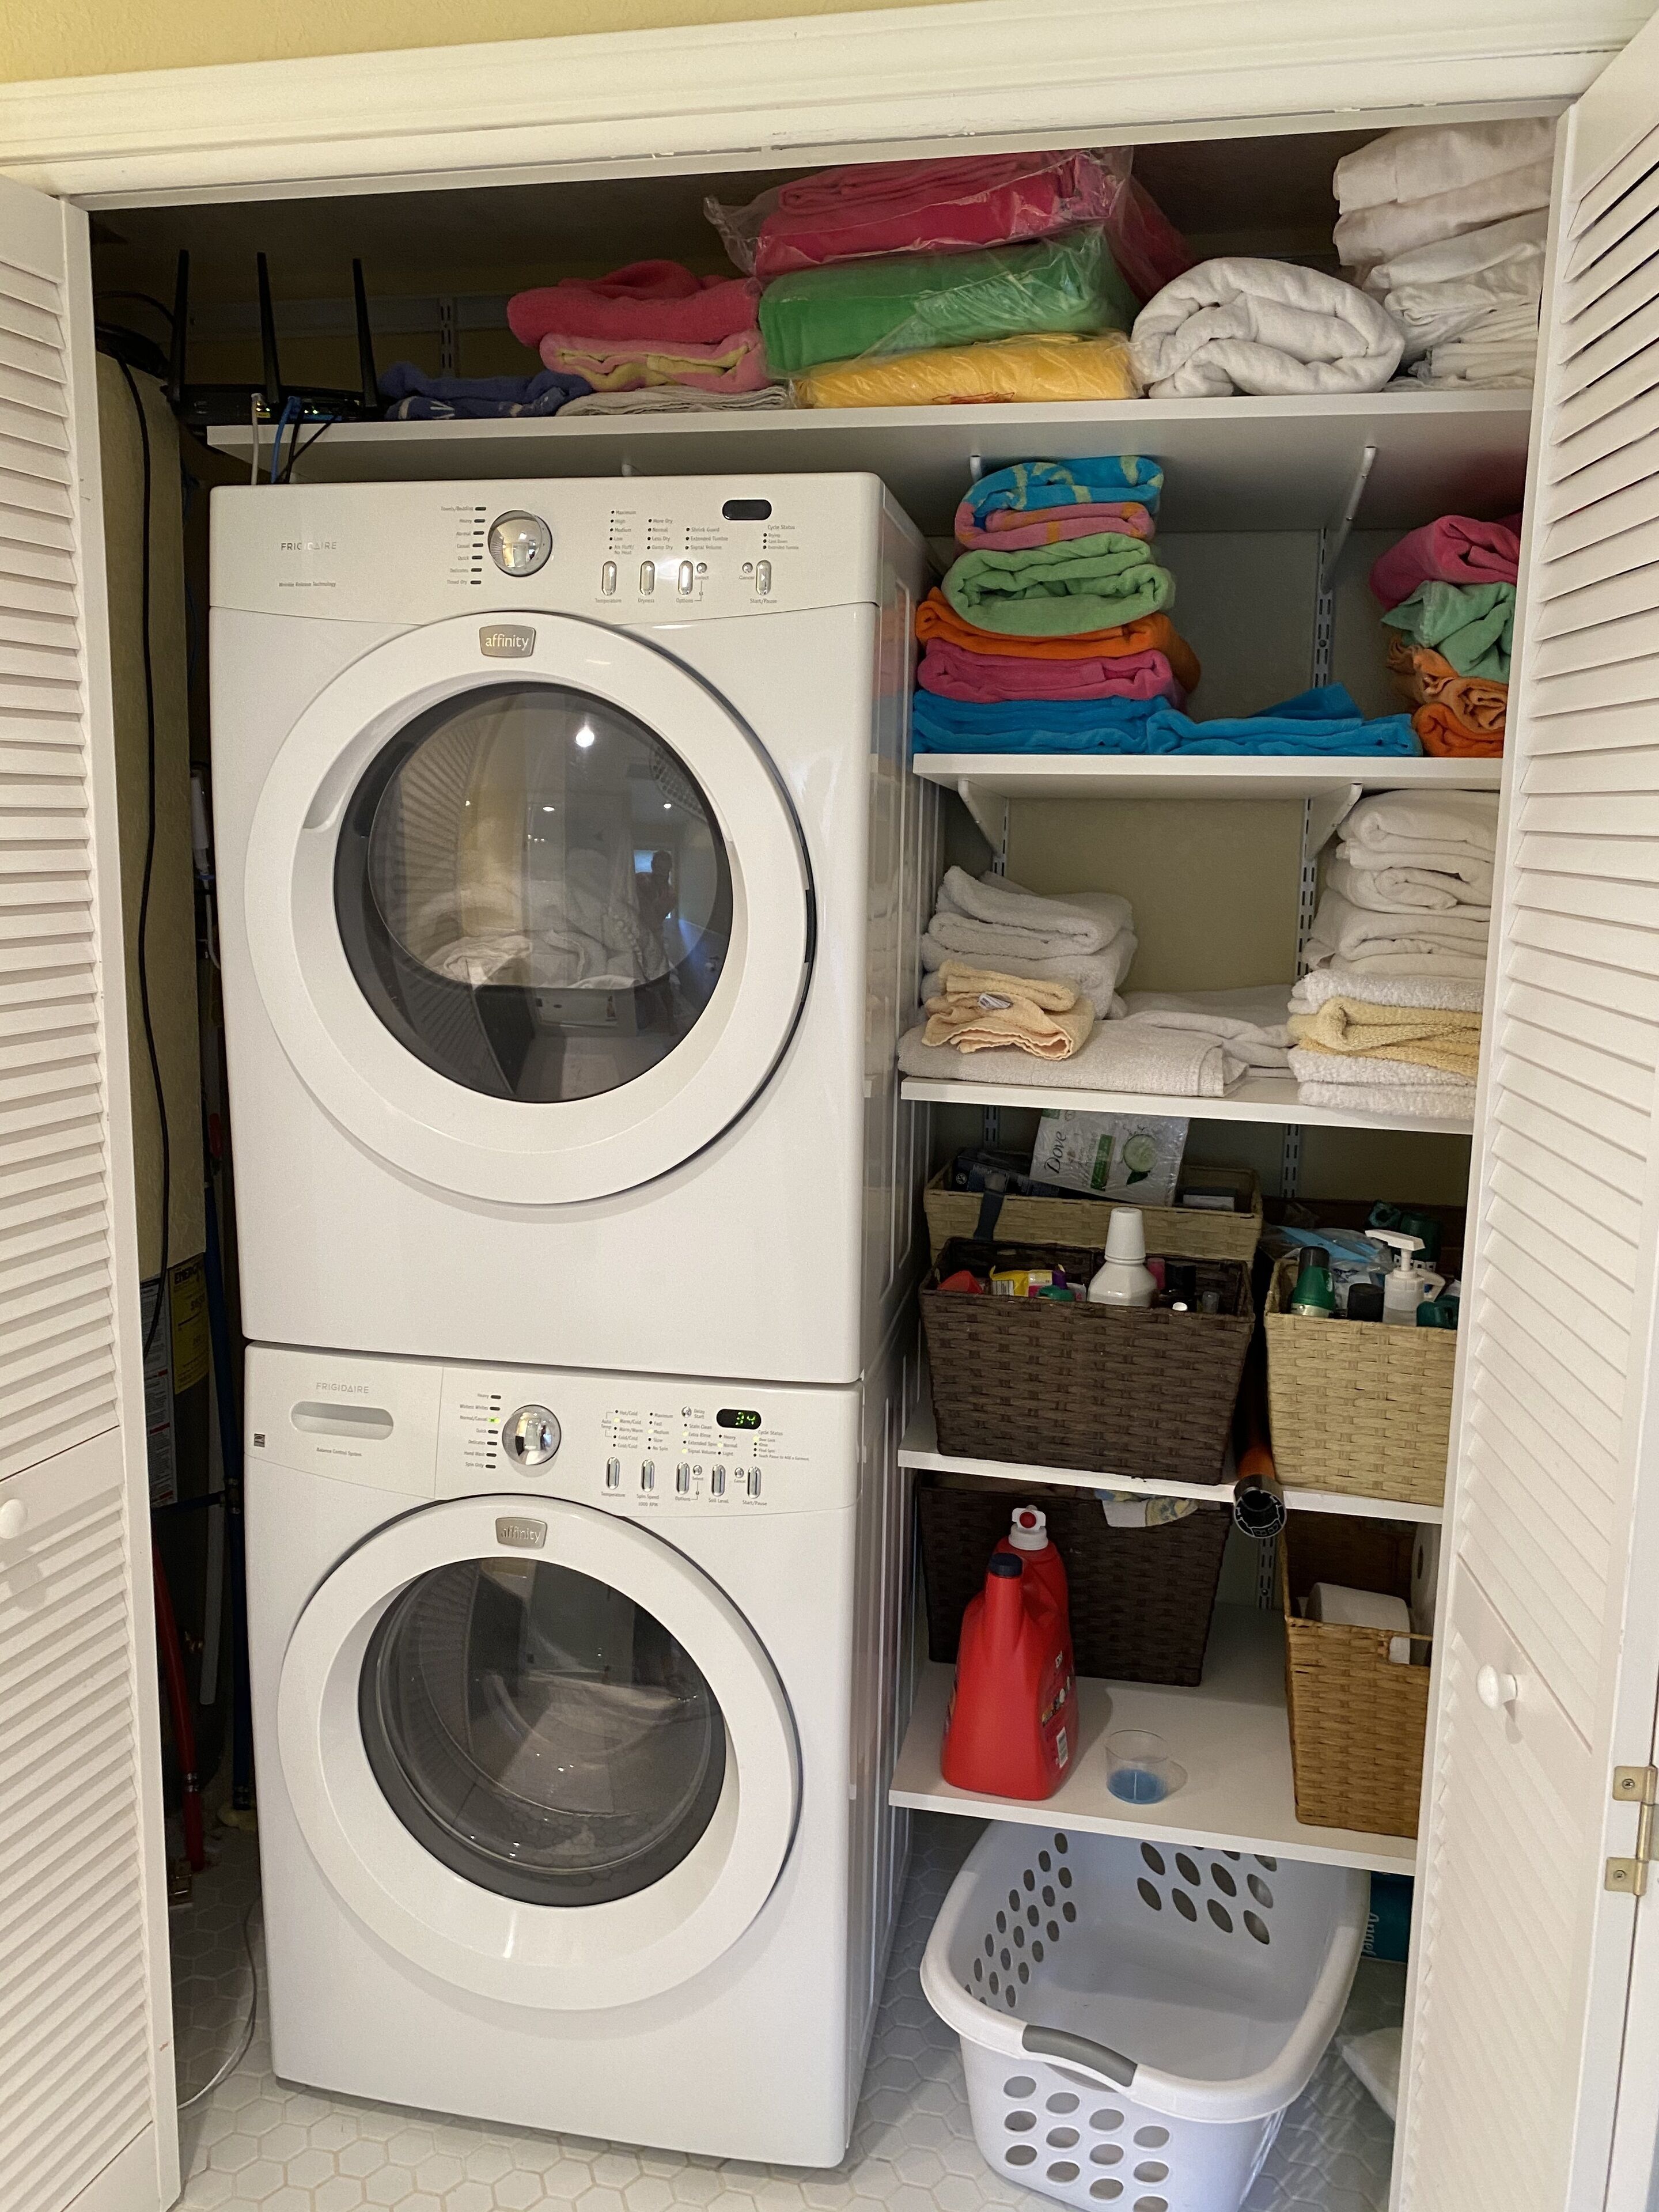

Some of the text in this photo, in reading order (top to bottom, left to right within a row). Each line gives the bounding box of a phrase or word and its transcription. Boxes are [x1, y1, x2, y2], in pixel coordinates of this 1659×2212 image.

[485, 633, 529, 651] affinity
[1044, 1131, 1067, 1173] Dove
[316, 1382, 369, 1393] FRIGIDAIRE
[735, 1411, 756, 1426] 34
[501, 1525, 541, 1544] affinity
